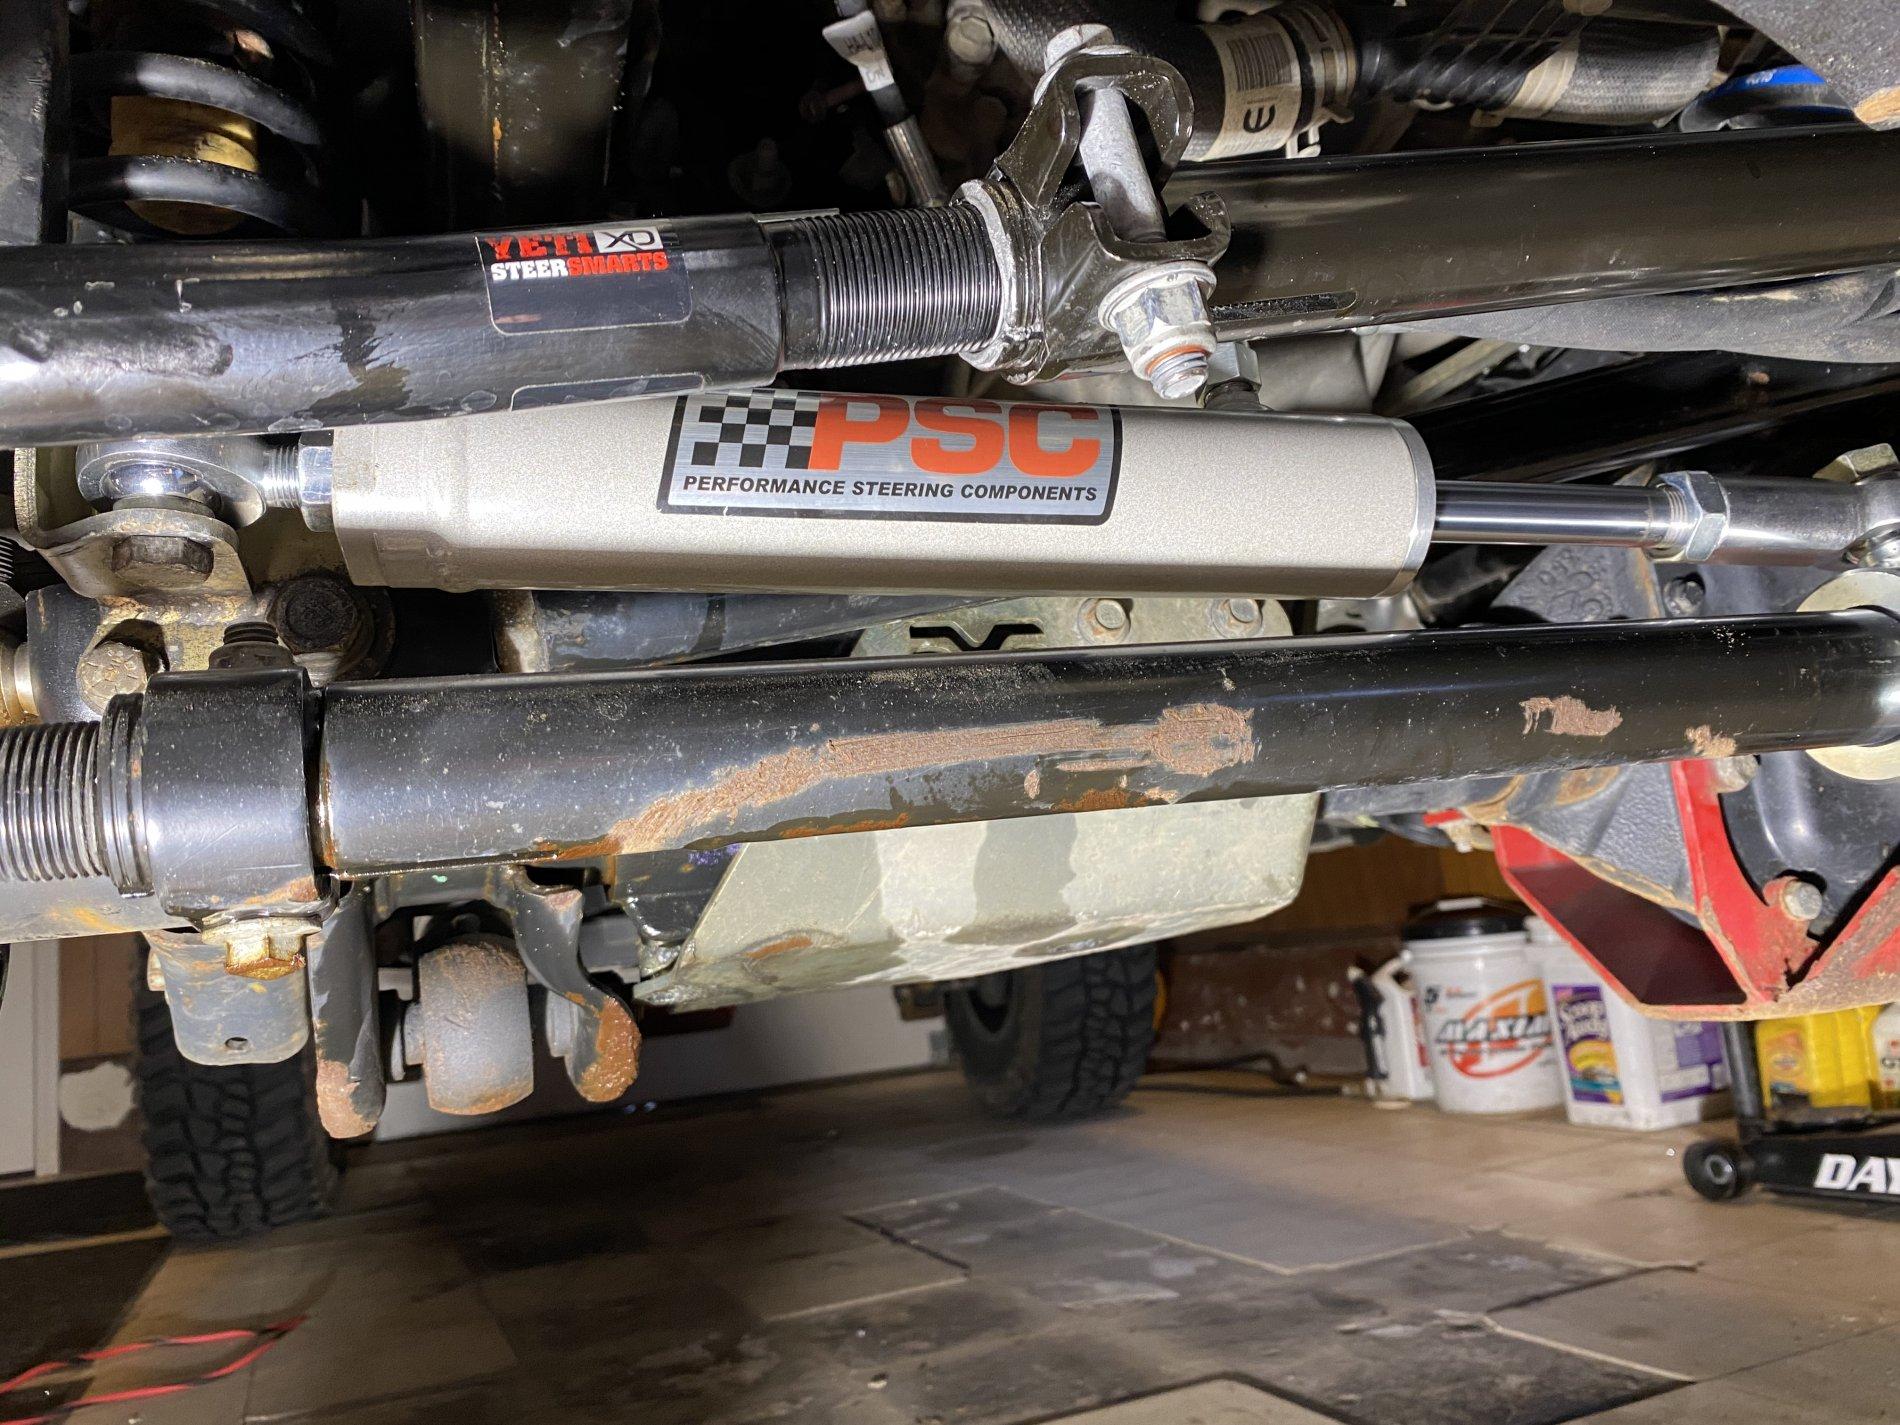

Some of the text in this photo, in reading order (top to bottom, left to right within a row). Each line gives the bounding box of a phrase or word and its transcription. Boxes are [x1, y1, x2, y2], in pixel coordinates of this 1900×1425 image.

[484, 231, 593, 260] YETI
[808, 393, 1100, 478] PSC
[683, 475, 1098, 502] PERFORMANCE STEERING COMPONENTS
